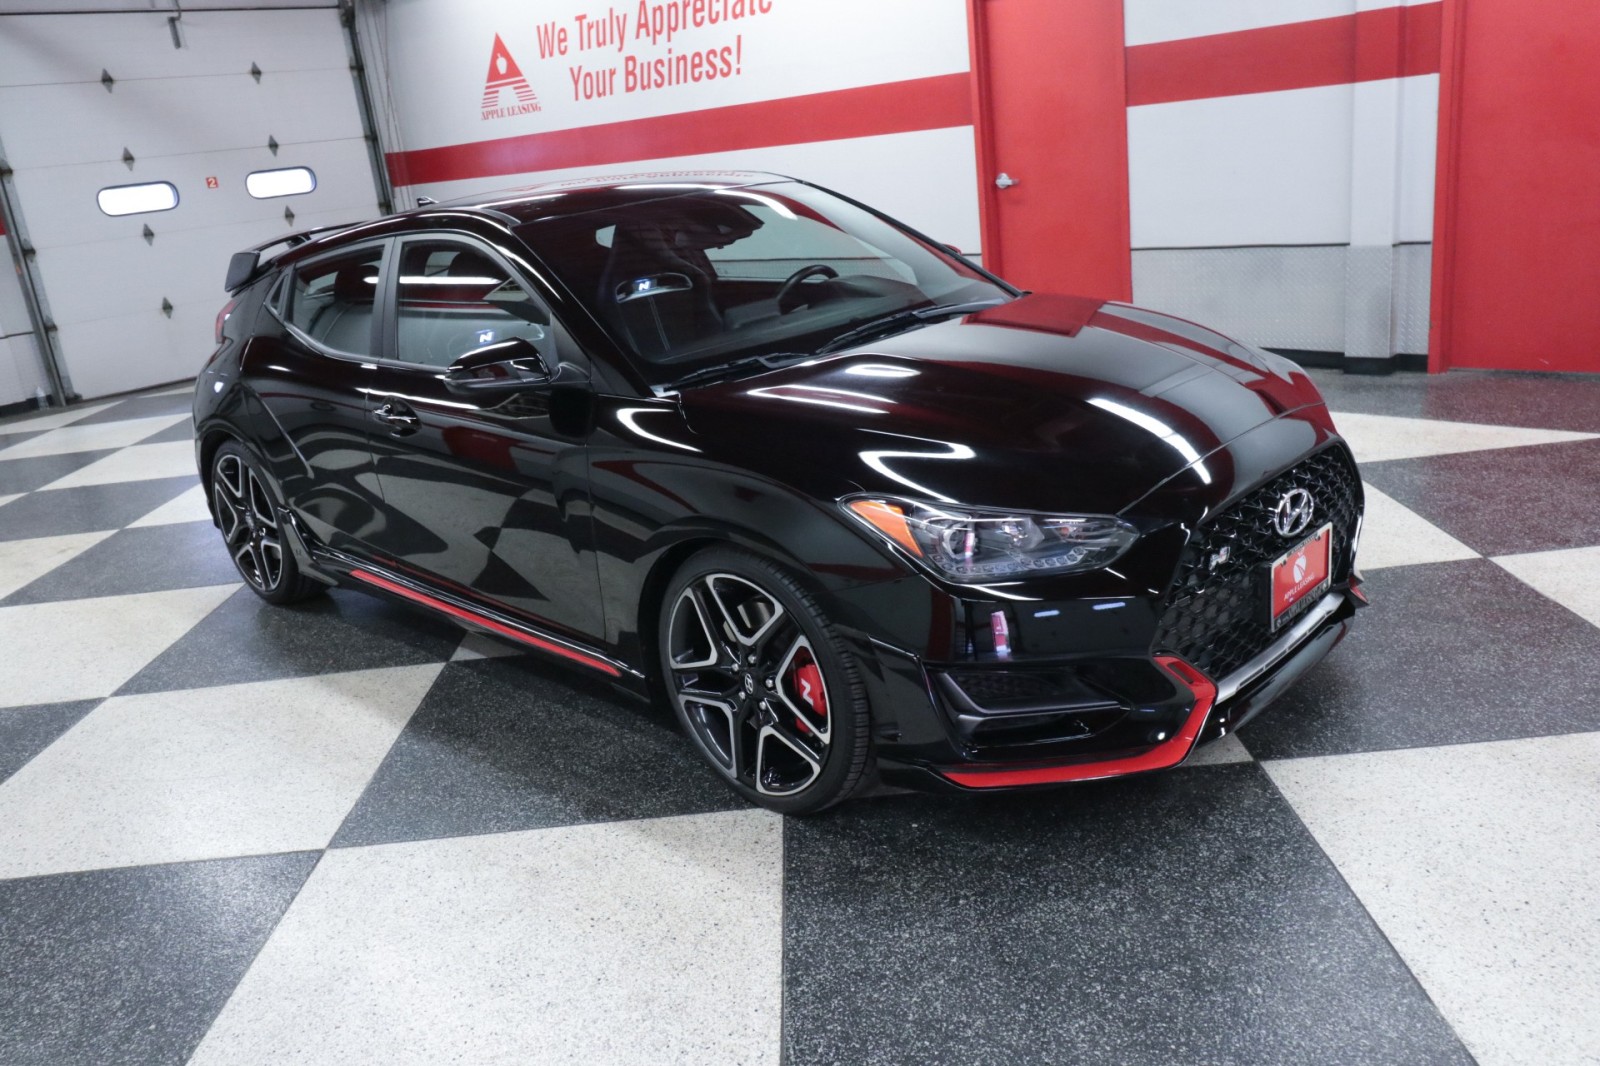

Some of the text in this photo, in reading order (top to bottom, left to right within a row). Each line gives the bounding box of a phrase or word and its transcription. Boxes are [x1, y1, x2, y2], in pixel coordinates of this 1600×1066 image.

[537, 22, 569, 60] We
[575, 7, 628, 52] Truly
[570, 34, 743, 101] Your Business!
[481, 102, 542, 120] APPLE LEASING
[208, 178, 217, 188] 2
